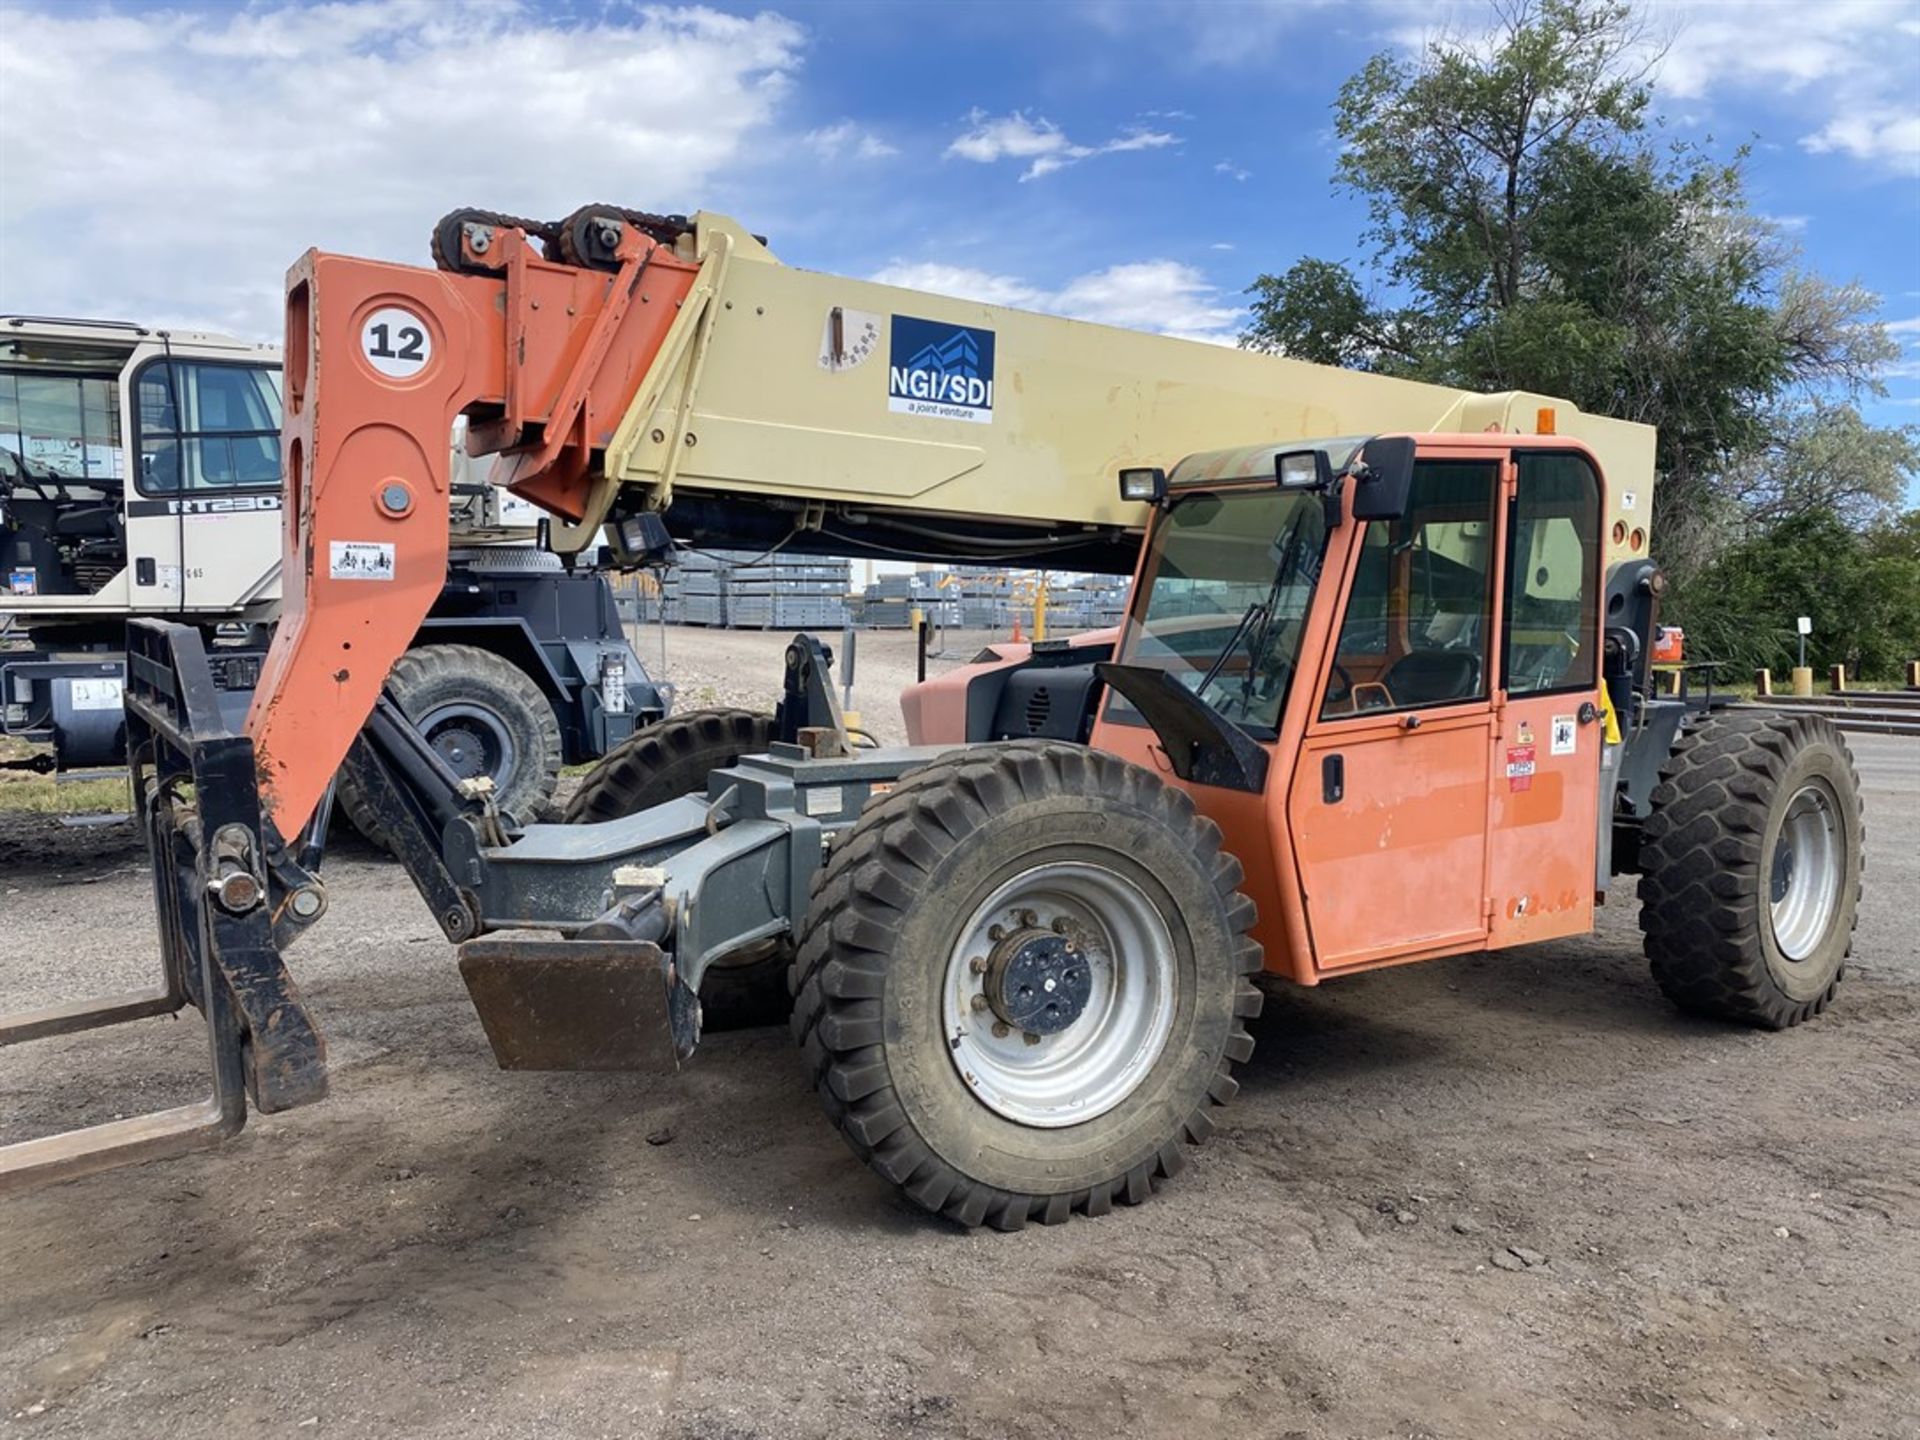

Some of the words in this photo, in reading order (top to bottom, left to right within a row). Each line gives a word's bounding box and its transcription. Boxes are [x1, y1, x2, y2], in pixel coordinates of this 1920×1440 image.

[370, 323, 424, 362] 12
[890, 366, 993, 407] NGI/SDI
[908, 403, 915, 411] a
[915, 403, 938, 414] joint
[940, 408, 975, 418] venture
